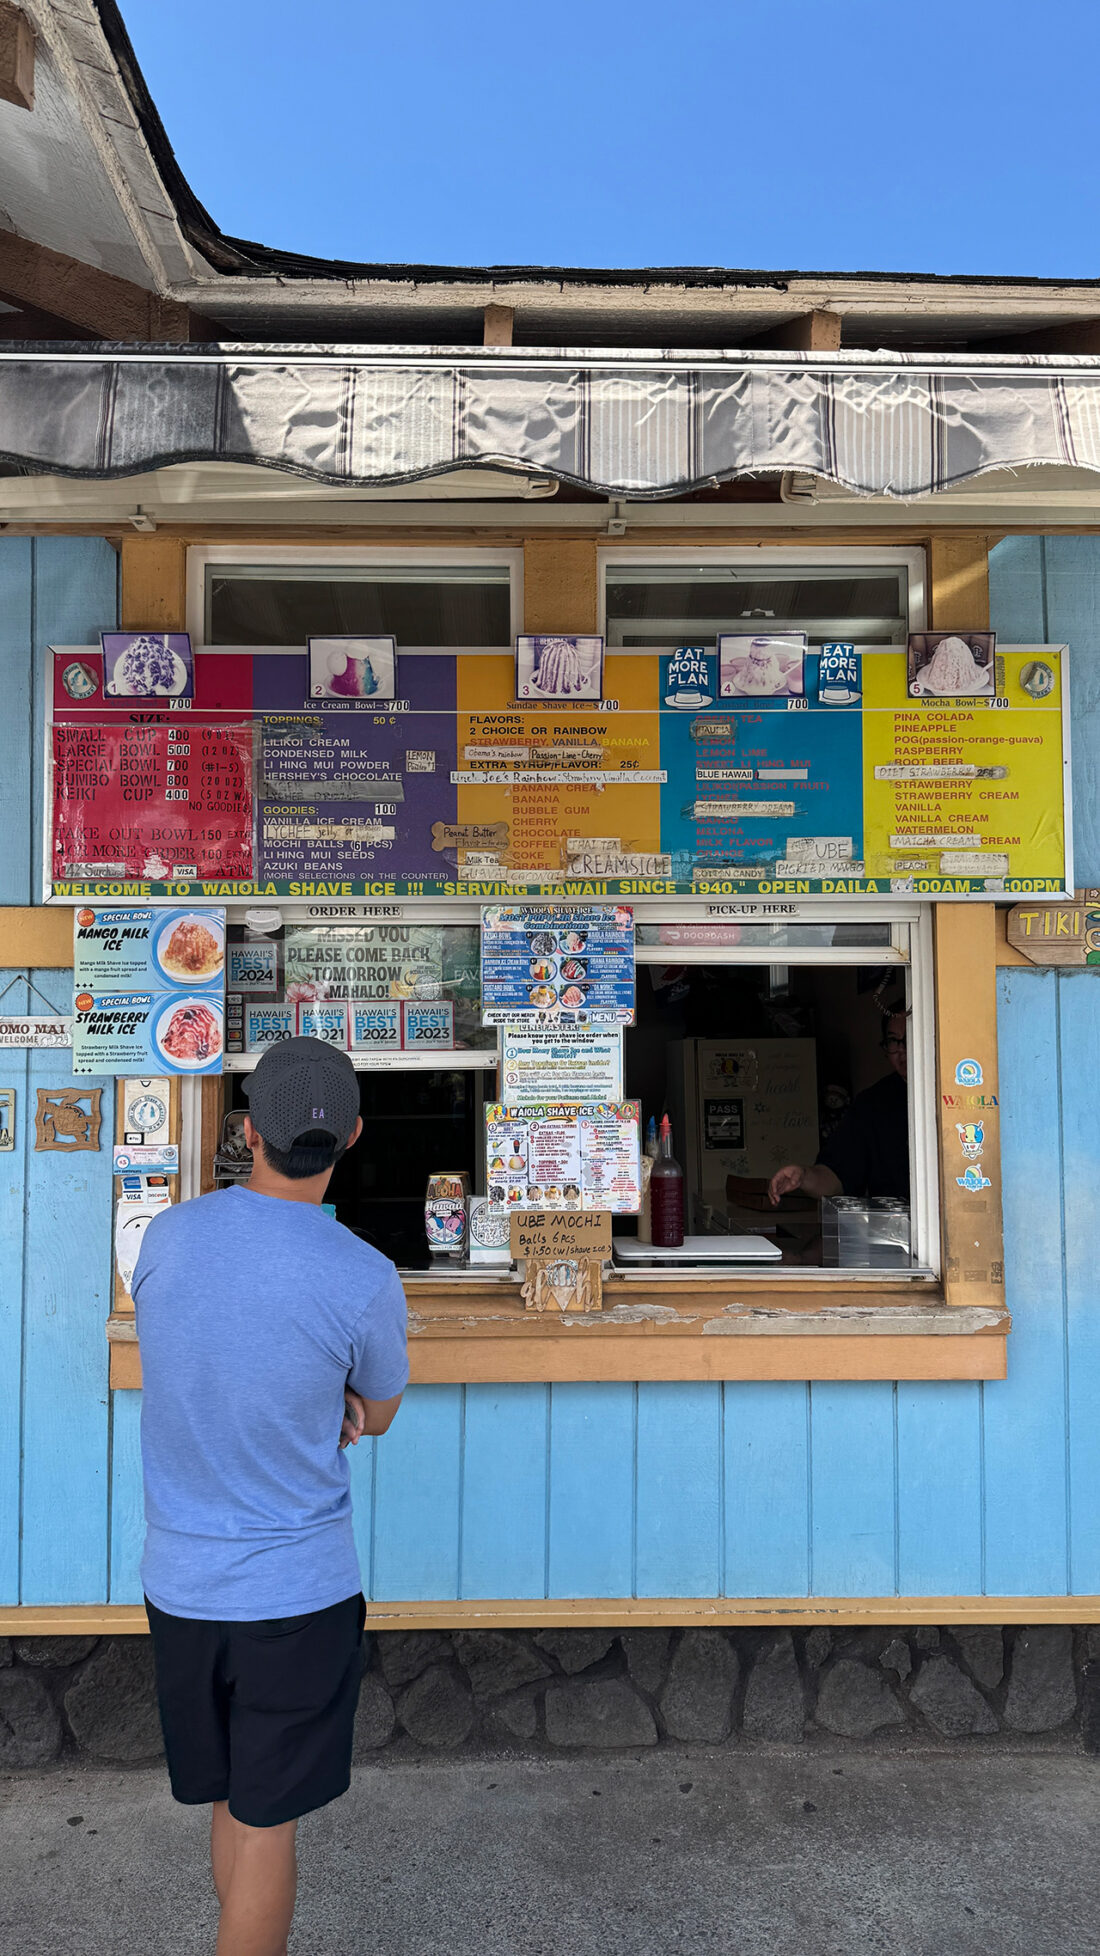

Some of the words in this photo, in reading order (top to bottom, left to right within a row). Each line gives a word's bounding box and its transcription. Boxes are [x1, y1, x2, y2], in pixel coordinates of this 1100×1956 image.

[675, 649, 703, 660] EAT
[823, 645, 852, 657] EAT
[669, 661, 707, 673] MORE
[820, 658, 857, 670] MORE
[668, 673, 708, 686] FLAN
[820, 670, 857, 682] FLAN
[170, 700, 191, 709] 700
[788, 699, 808, 710] 700
[470, 715, 525, 725] FLAVORS:
[894, 713, 921, 721] PINA
[926, 713, 974, 721] COLADA
[470, 726, 476, 736] 2
[482, 726, 525, 735] CHOICE
[531, 726, 548, 735] OR
[553, 726, 608, 735] RAINBOW
[894, 724, 957, 733] PINEAPPLE
[57, 730, 106, 743] SMALL
[124, 729, 156, 742] CUP
[168, 730, 190, 742] 400
[263, 739, 303, 747] LILIKOI
[309, 739, 350, 747] CREAM
[58, 744, 106, 758] LARGE
[119, 744, 160, 757] BOWL
[168, 745, 190, 756] 500
[263, 750, 335, 758] CONDENSED
[341, 750, 368, 758] MILK
[407, 751, 434, 761] LEMON
[894, 747, 963, 755] RASPBERRY
[263, 761, 274, 770] LI
[279, 761, 307, 770] HING
[313, 761, 334, 770] MUI
[340, 761, 390, 770] POWDER
[263, 772, 328, 780] HERSHEY'S
[333, 772, 403, 781] CHOCOLATE
[697, 770, 719, 779] BLUE
[722, 770, 752, 779] HAWAII
[512, 784, 560, 792] BANANA
[895, 781, 973, 789] STRAWBERRY
[56, 787, 97, 801] KEIKI
[123, 789, 153, 801] CUP
[166, 789, 189, 800] 400
[895, 792, 973, 800] STRAWBERRY
[979, 792, 1020, 800] CREAM
[512, 796, 560, 804] BANANA
[263, 806, 319, 815] GOODIES:
[375, 804, 397, 815] 100
[512, 807, 558, 815] BUBBLE
[895, 804, 942, 812] VANILLA
[512, 818, 558, 826] CHERRY
[895, 815, 942, 823] VANILLA
[948, 815, 989, 823] CREAM
[266, 825, 313, 839] LYCHEE
[443, 827, 469, 839] Peanut
[472, 826, 497, 838] Butter
[512, 829, 581, 837] CHOCOLATE
[512, 840, 557, 849] COFFEE
[980, 836, 1021, 845] CREAM
[264, 851, 274, 860] LI
[277, 851, 305, 860] HING
[311, 851, 331, 860] MUI
[337, 851, 375, 860] SEEDS
[512, 851, 544, 860] COKE
[815, 843, 849, 859] UBE
[467, 855, 482, 864] Milk
[484, 856, 499, 864] Tea
[571, 854, 670, 876] CREAMSICLE
[177, 868, 194, 876] VISA
[264, 862, 298, 871] AZUKI
[304, 862, 343, 871] BEANS
[54, 884, 151, 896] WELCOME
[165, 884, 190, 896] TO
[202, 884, 277, 896] WAIOLA
[289, 882, 353, 896] SHAVE
[365, 882, 396, 896] ICE
[408, 882, 424, 896] !!!
[436, 882, 528, 896] "SERVING
[540, 881, 607, 895] HAWAII
[619, 881, 677, 894] SINCE
[758, 881, 809, 893] OPEN
[822, 880, 879, 893] DAILA
[309, 906, 356, 917] ORDER
[363, 906, 401, 917] HERE
[709, 905, 758, 916] PICK-UP
[762, 904, 797, 915] HERE
[102, 912, 131, 922] SPECIAL
[132, 911, 152, 920] BOWL
[1019, 911, 1080, 936] TIKI
[77, 928, 118, 940] MANGO
[122, 928, 149, 939] MILK
[379, 927, 410, 942] YOU
[103, 940, 123, 951] ICE
[231, 950, 274, 958] HAWAII'S
[288, 947, 341, 963] PLEASE
[346, 947, 387, 963] COME
[391, 947, 430, 962] BACK
[231, 958, 274, 970] BEST
[239, 970, 274, 982] 2024
[312, 966, 402, 982] TOMORROW
[329, 985, 390, 999] MAHALO!
[101, 997, 131, 1007] SPECIAL
[131, 996, 151, 1004] BOWL
[75, 1011, 149, 1024] STRAWBERRY
[250, 1010, 292, 1018] HAWAII'S
[303, 1009, 344, 1017] HAWAII'S
[355, 1009, 396, 1017] HAWAII'S
[407, 1008, 449, 1016] HAWAII'S
[591, 1012, 615, 1023] MENU
[250, 1018, 292, 1030] BEST
[303, 1017, 344, 1029] BEST
[355, 1016, 396, 1028] BEST
[407, 1016, 449, 1028] BEST
[34, 1024, 65, 1034] MAI
[87, 1024, 114, 1035] MILK
[117, 1024, 137, 1035] ICE
[310, 1029, 344, 1040] 2021
[363, 1029, 397, 1040] 2022
[415, 1028, 450, 1040] 2023
[257, 1030, 293, 1042] 2020
[942, 1095, 999, 1107] WAIOLA
[312, 1107, 325, 1119] EA
[509, 1106, 544, 1118] WAIOLA
[546, 1106, 577, 1117] SHAVE
[578, 1106, 594, 1116] ICE
[709, 1104, 738, 1114] PASS
[517, 1214, 546, 1228] UBE
[551, 1214, 602, 1228] MOCHI
[523, 1246, 551, 1257] $1.50
